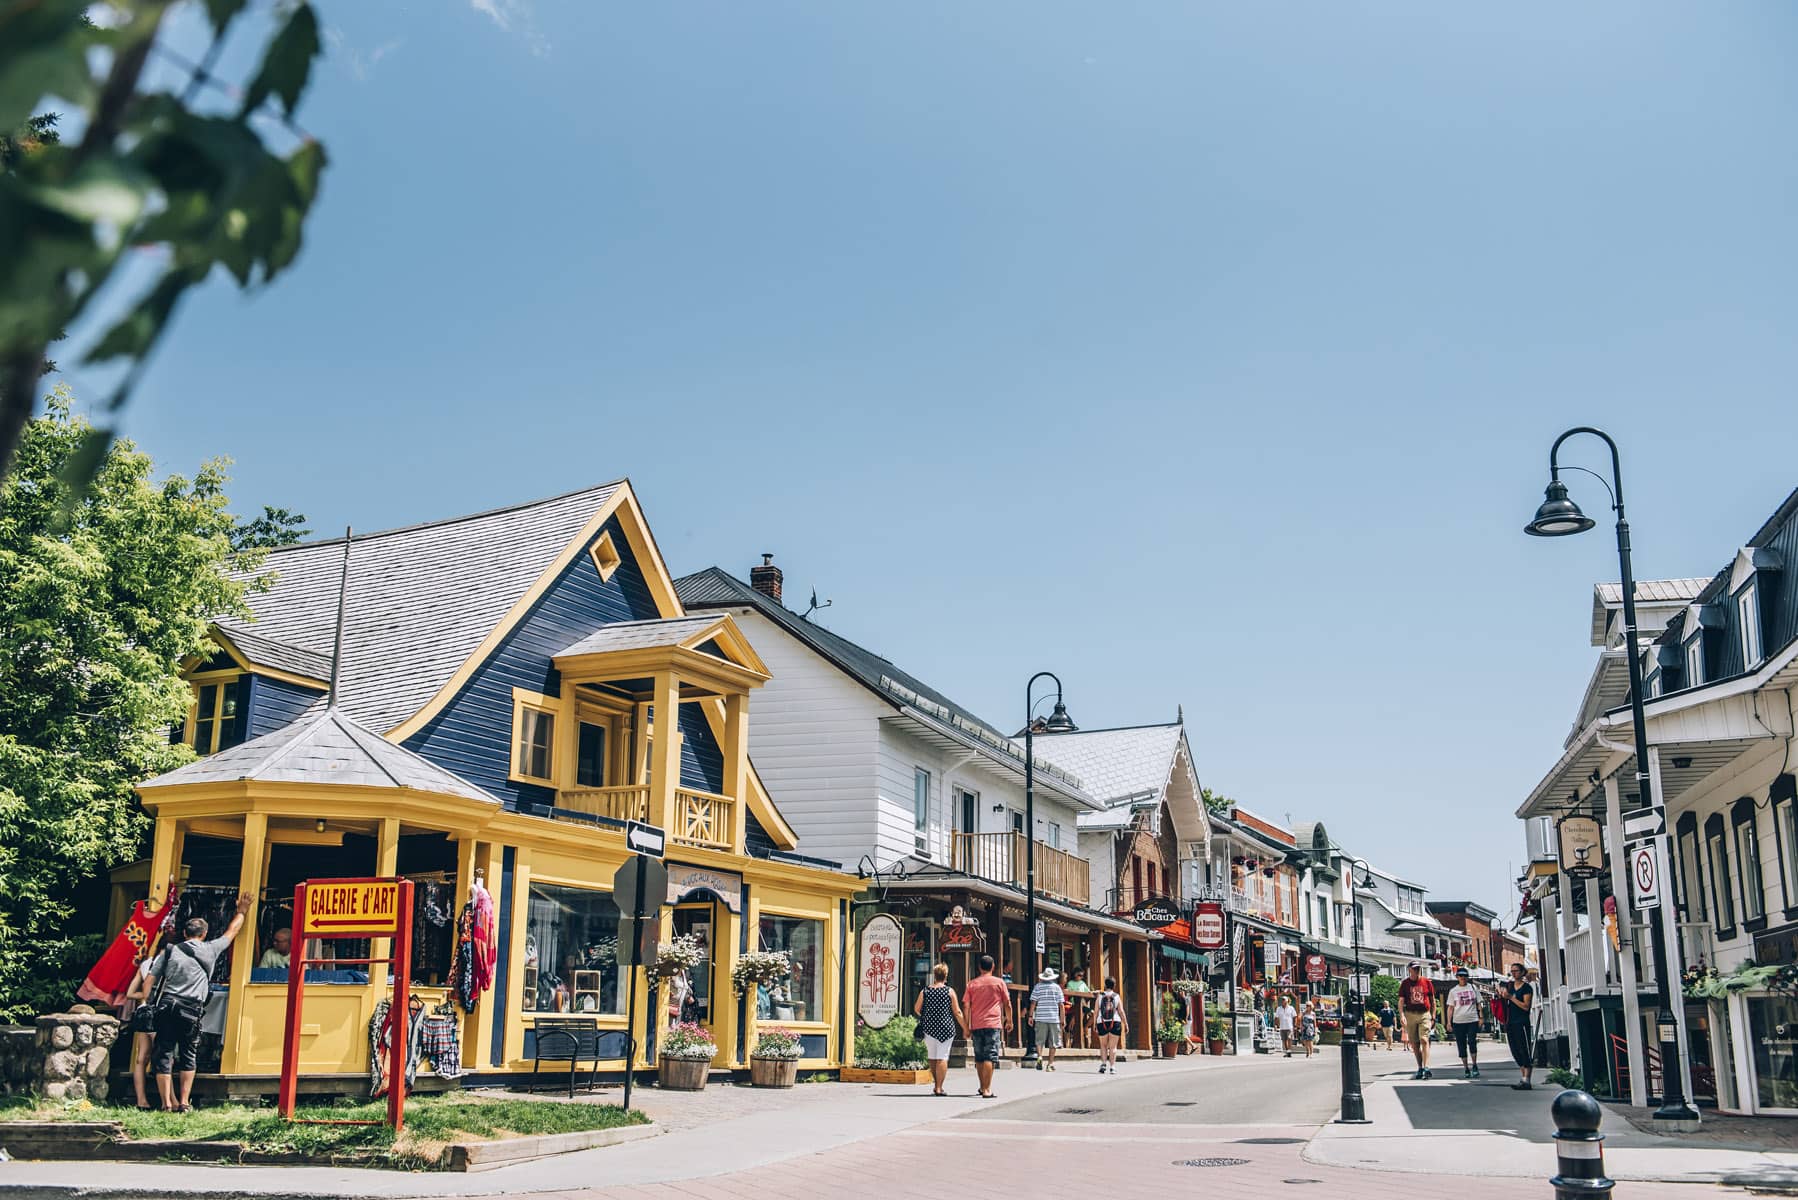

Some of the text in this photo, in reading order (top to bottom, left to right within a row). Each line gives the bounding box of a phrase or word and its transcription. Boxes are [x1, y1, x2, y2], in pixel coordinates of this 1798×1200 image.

[311, 887, 396, 915] GALERIE d'ART
[1136, 908, 1177, 921] Bocaux
[942, 925, 974, 950] Joe
